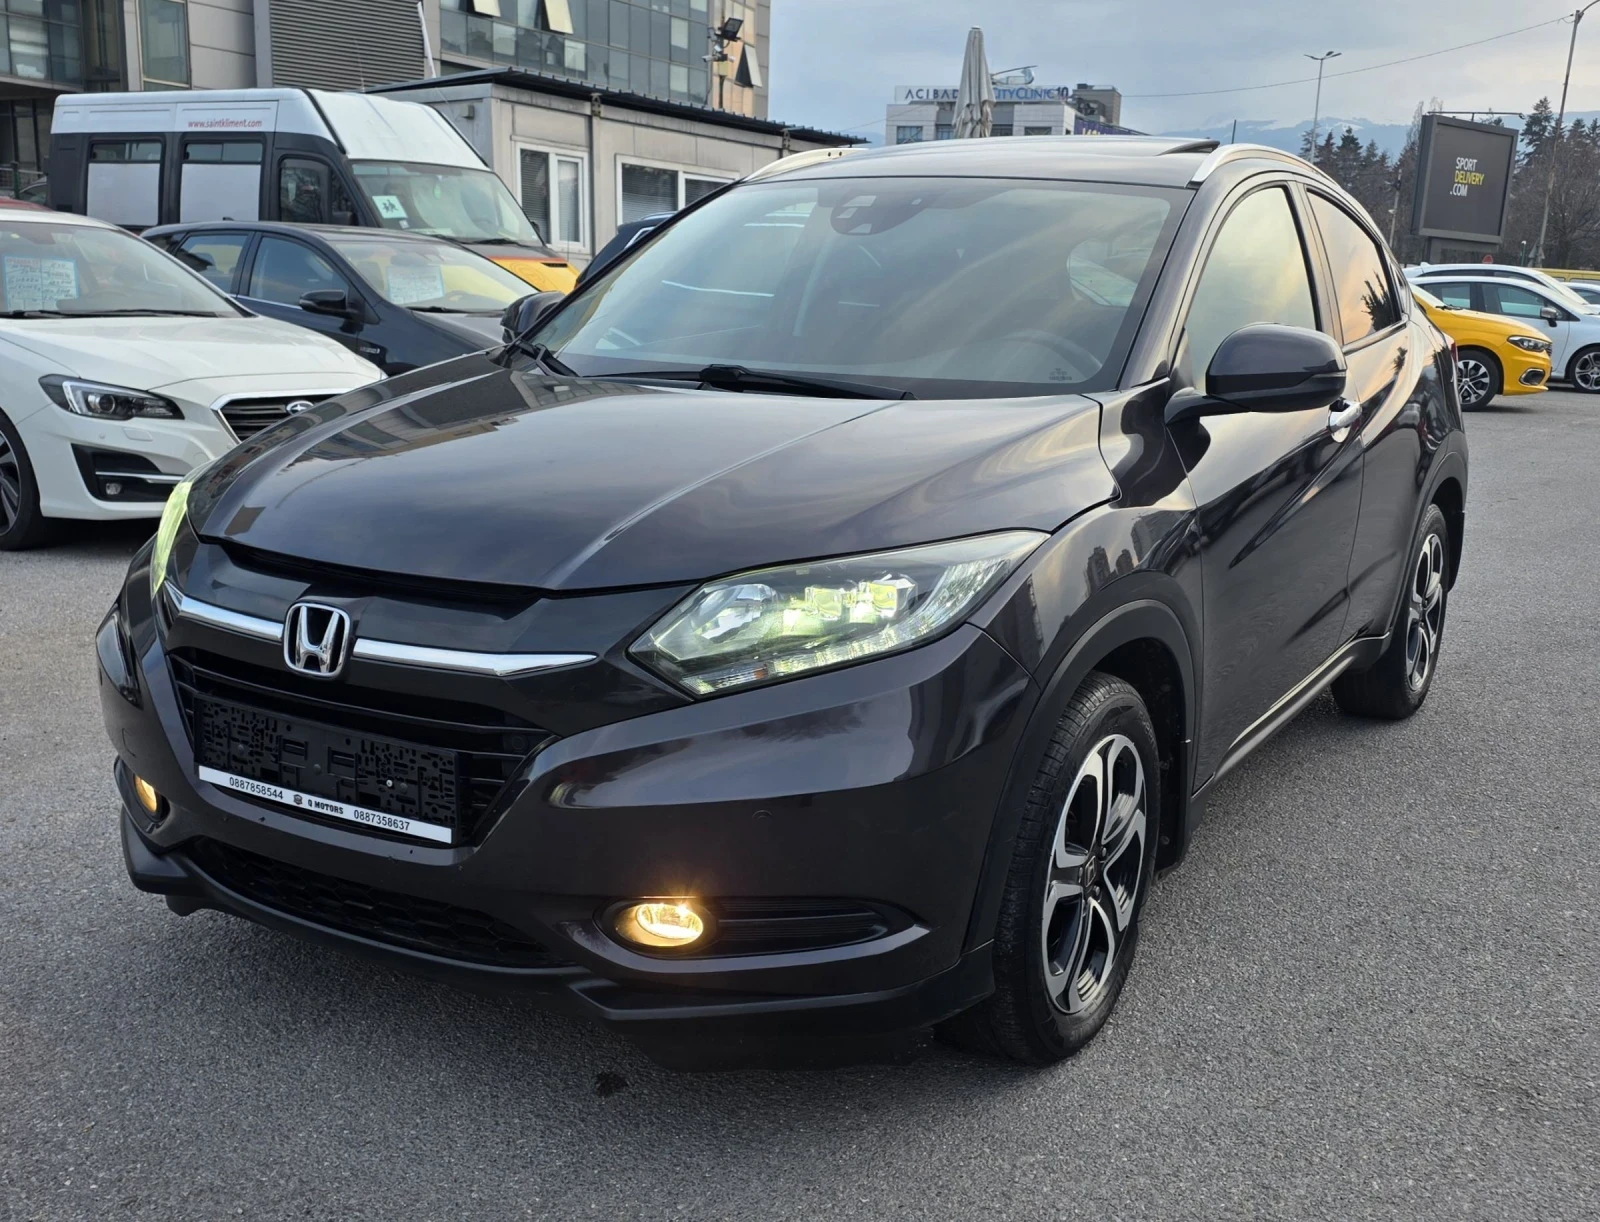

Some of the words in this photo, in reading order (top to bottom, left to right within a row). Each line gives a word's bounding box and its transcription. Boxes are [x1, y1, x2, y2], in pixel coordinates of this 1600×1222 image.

[905, 88, 960, 99] ACIBAD
[188, 118, 262, 128] www.saintkliment.com
[1455, 157, 1478, 171] SPORT
[1454, 170, 1484, 185] DELIVERY
[1449, 183, 1468, 196] .COM
[228, 776, 284, 801] 0887858544
[314, 801, 344, 815] MOTORS
[353, 809, 411, 832] 0887358637
